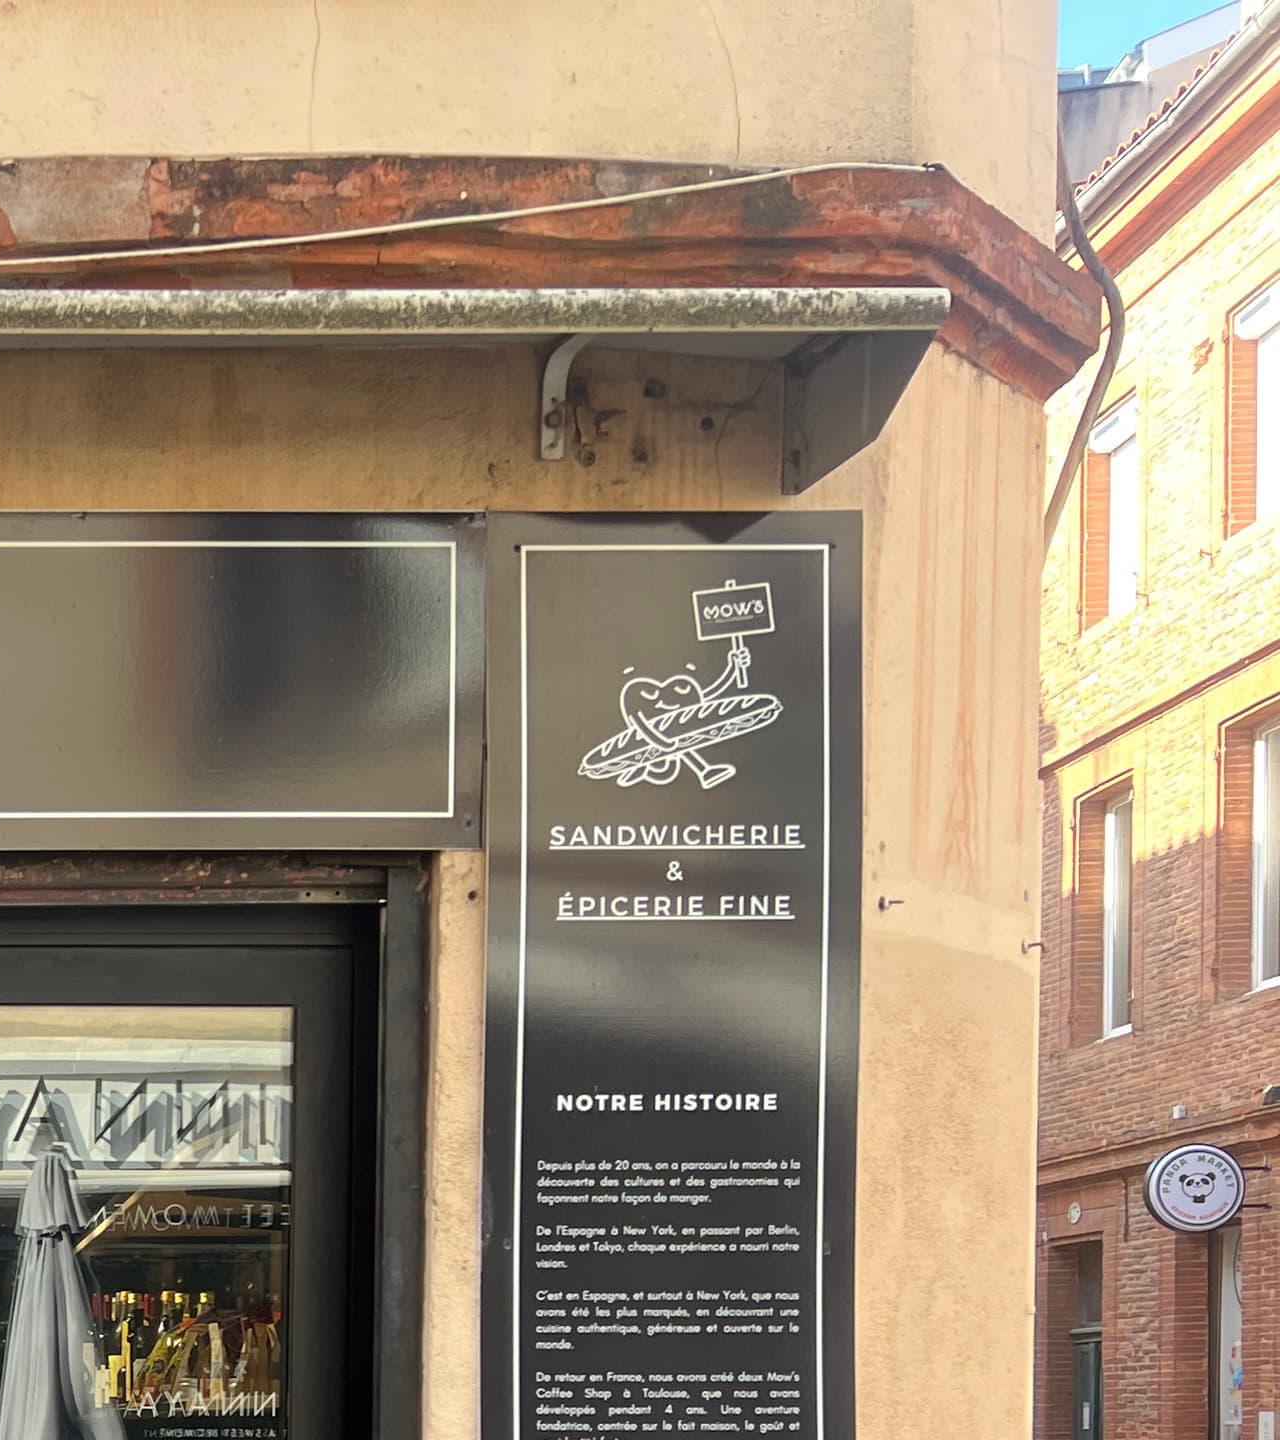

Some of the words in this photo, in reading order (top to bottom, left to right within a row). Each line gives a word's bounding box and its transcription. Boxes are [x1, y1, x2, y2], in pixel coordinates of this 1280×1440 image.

[702, 599, 764, 620] MOW'S
[549, 824, 802, 846] SANDWICHERIE
[666, 861, 684, 882] &
[557, 892, 704, 917] ÉPICERIE
[719, 895, 792, 917] FINE
[556, 1094, 644, 1112] NOTRE
[654, 1093, 778, 1111] HISTOIRE
[537, 1159, 573, 1173] Depuis
[574, 1159, 597, 1174] plus
[597, 1159, 613, 1171] de
[614, 1159, 630, 1171] 20
[631, 1162, 653, 1171] ans,
[654, 1162, 669, 1171] on
[670, 1162, 679, 1171] a
[680, 1162, 728, 1173] parcouru
[729, 1159, 740, 1170] le
[741, 1158, 778, 1170] monde
[779, 1159, 789, 1170] à
[789, 1158, 801, 1170] la
[1161, 1158, 1188, 1194] PANDA
[1197, 1155, 1235, 1188] MARKET
[536, 1175, 596, 1188] découverte
[599, 1175, 620, 1187] des
[623, 1175, 665, 1187] cultures
[668, 1177, 681, 1187] et
[685, 1175, 706, 1187] des
[709, 1176, 779, 1190] gastronomies
[783, 1176, 801, 1189] qui
[536, 1191, 590, 1206] façonnent
[591, 1193, 619, 1203] notre
[620, 1191, 652, 1206] façon
[652, 1191, 668, 1203] de
[669, 1194, 712, 1206] manger.
[535, 1225, 552, 1236] De
[555, 1224, 607, 1239] l'Espagne
[610, 1225, 619, 1236] à
[622, 1225, 647, 1236] New
[650, 1224, 678, 1237] York,
[681, 1227, 696, 1236] en
[699, 1225, 741, 1238] passant
[744, 1227, 764, 1238] par
[767, 1223, 801, 1236] Berlin,
